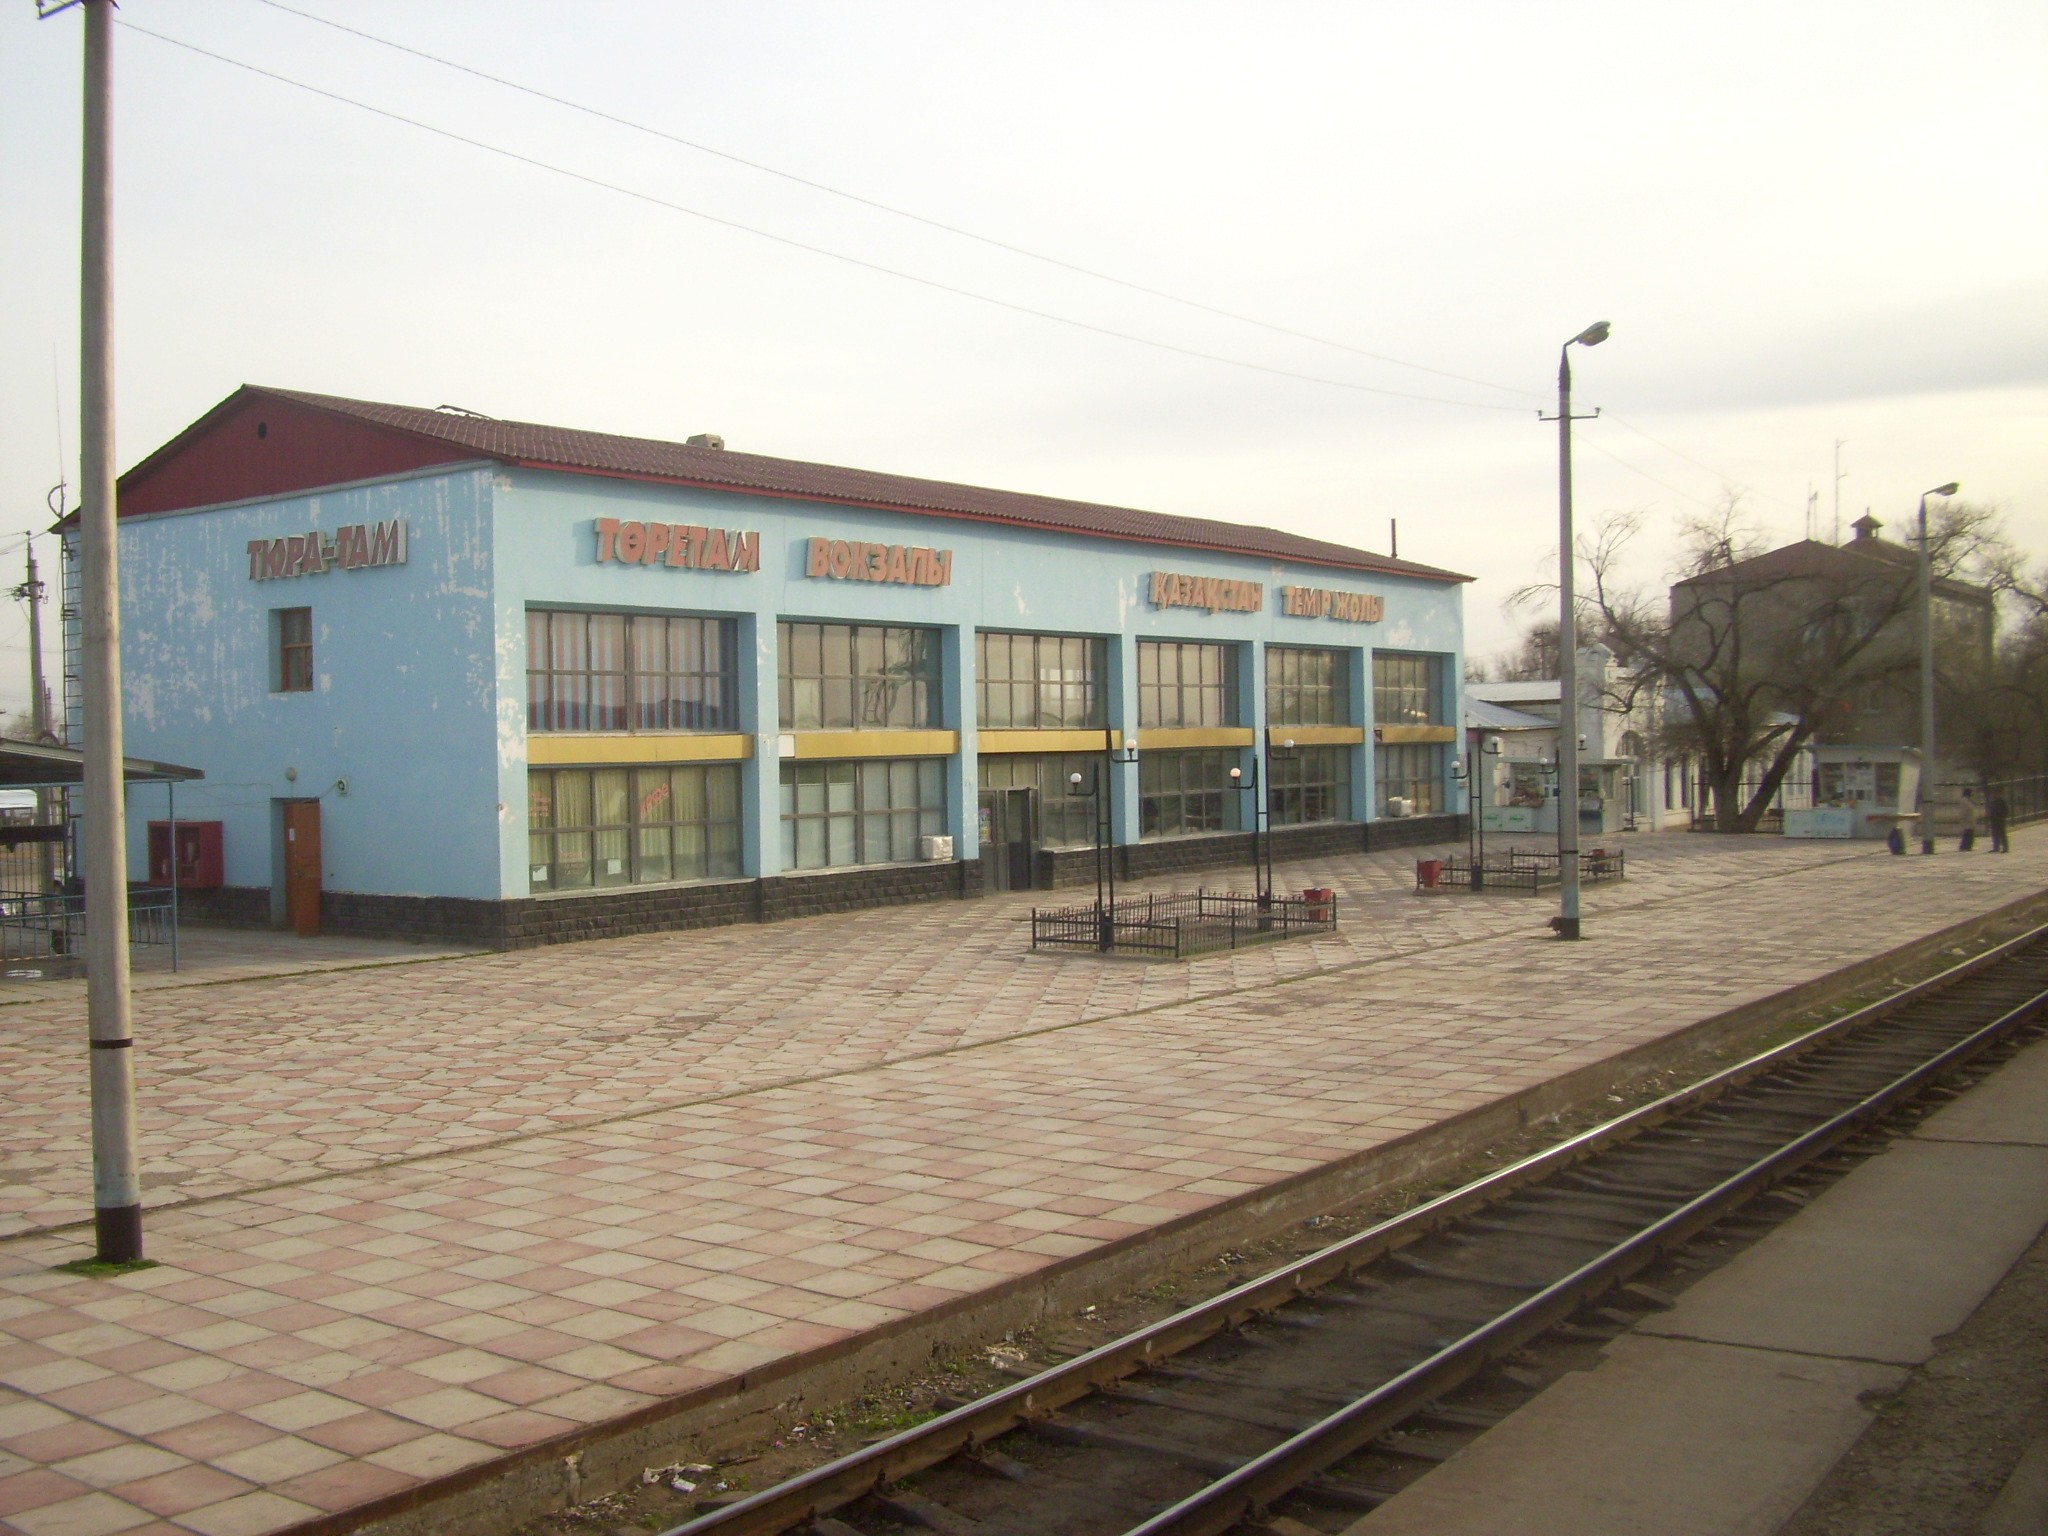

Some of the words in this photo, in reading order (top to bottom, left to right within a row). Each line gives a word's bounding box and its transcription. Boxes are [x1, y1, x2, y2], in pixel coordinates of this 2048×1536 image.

[247, 519, 406, 582] ТЮРА-ТАМ
[594, 516, 760, 573] ТӨРЕТАМ
[806, 535, 952, 587] ВОКЗАЛЫ
[1332, 590, 1384, 622] ЖОЛЫ
